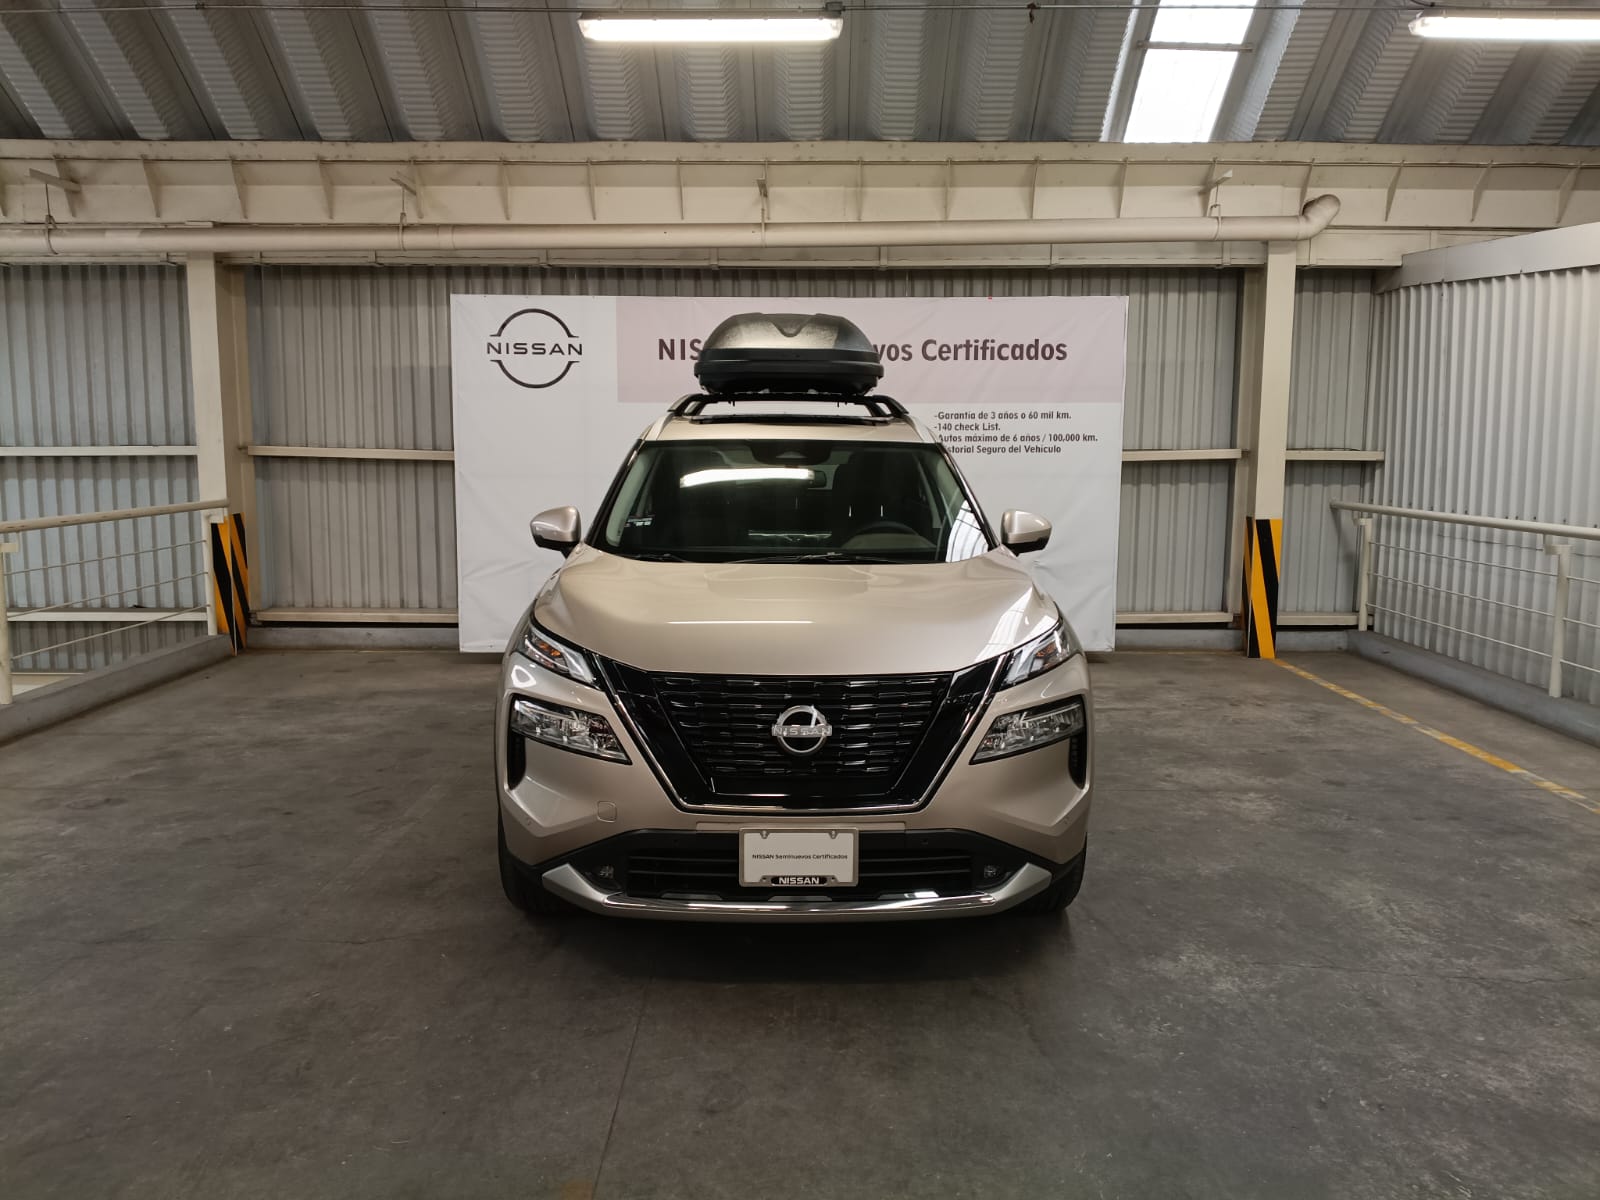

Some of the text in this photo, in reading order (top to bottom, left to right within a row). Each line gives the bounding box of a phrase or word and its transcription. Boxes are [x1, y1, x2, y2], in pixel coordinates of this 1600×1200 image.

[487, 342, 582, 356] NISSAN
[658, 338, 702, 361] NIS
[921, 338, 1068, 361] Certificados
[978, 411, 988, 419] de
[990, 411, 996, 419] 3
[998, 410, 1018, 419] años
[1028, 411, 1039, 419] 60
[1040, 411, 1054, 419] mil
[1056, 411, 1072, 419] km.
[934, 423, 1001, 431] -140 check List.
[964, 433, 998, 442] máximo
[1000, 434, 1010, 442] de
[1012, 434, 1018, 442] 6
[1020, 433, 1041, 442] años
[1041, 433, 1047, 443] /
[1049, 433, 1081, 442] 100,000
[1082, 433, 1098, 442] km.
[947, 445, 974, 453] storial
[976, 445, 1006, 455] Seguro
[1008, 445, 1021, 453] del
[773, 727, 831, 736] NISSAN
[778, 877, 819, 885] NISSAN
